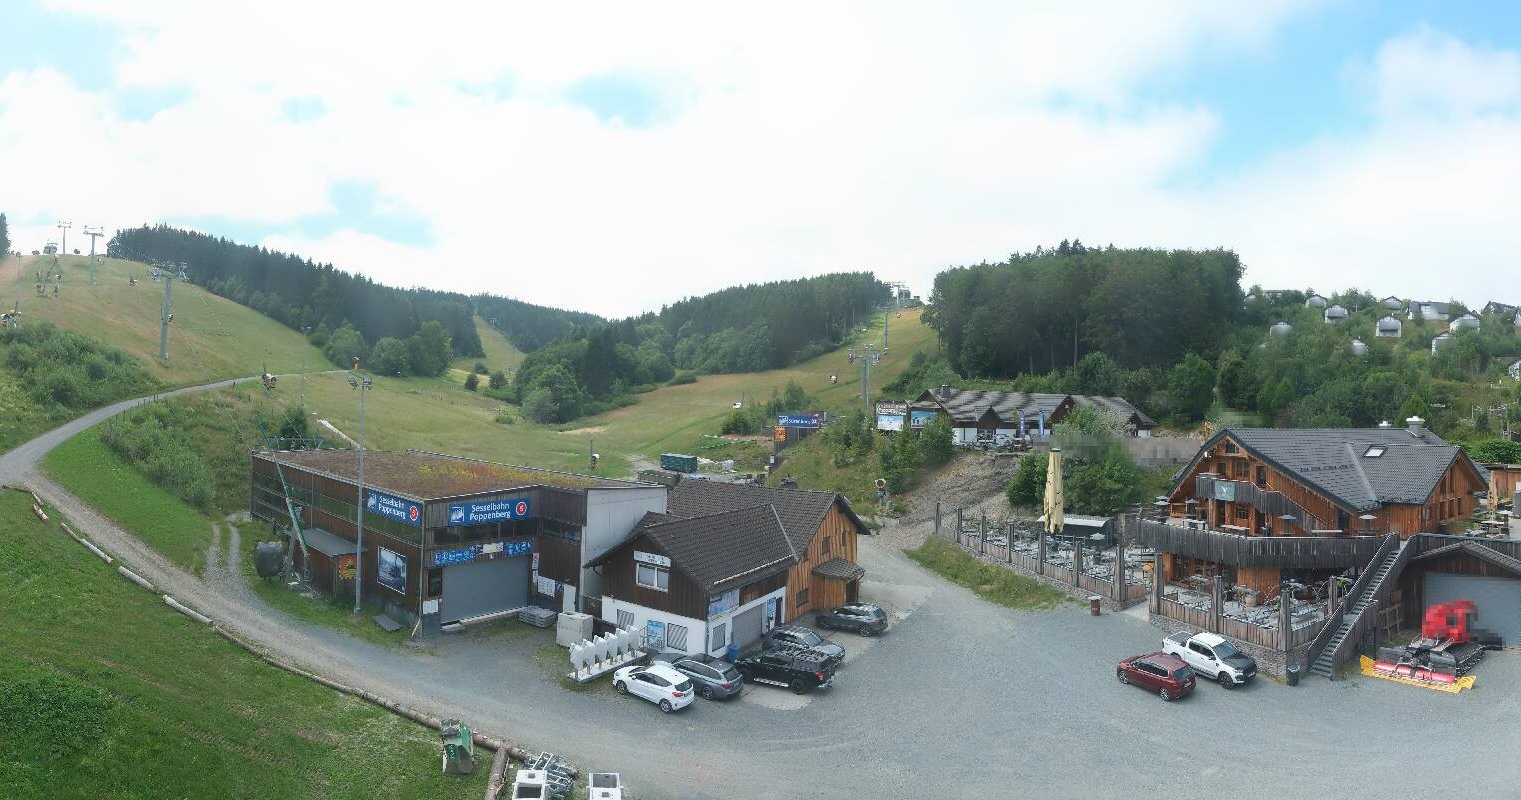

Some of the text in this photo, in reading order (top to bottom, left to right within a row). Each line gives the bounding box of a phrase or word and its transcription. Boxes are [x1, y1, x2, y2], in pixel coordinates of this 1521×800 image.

[379, 495, 405, 509] Sesselbahn
[471, 501, 510, 513] Sesselbahn
[378, 503, 406, 520] Poppenberg
[469, 510, 511, 522] Poppenberg
